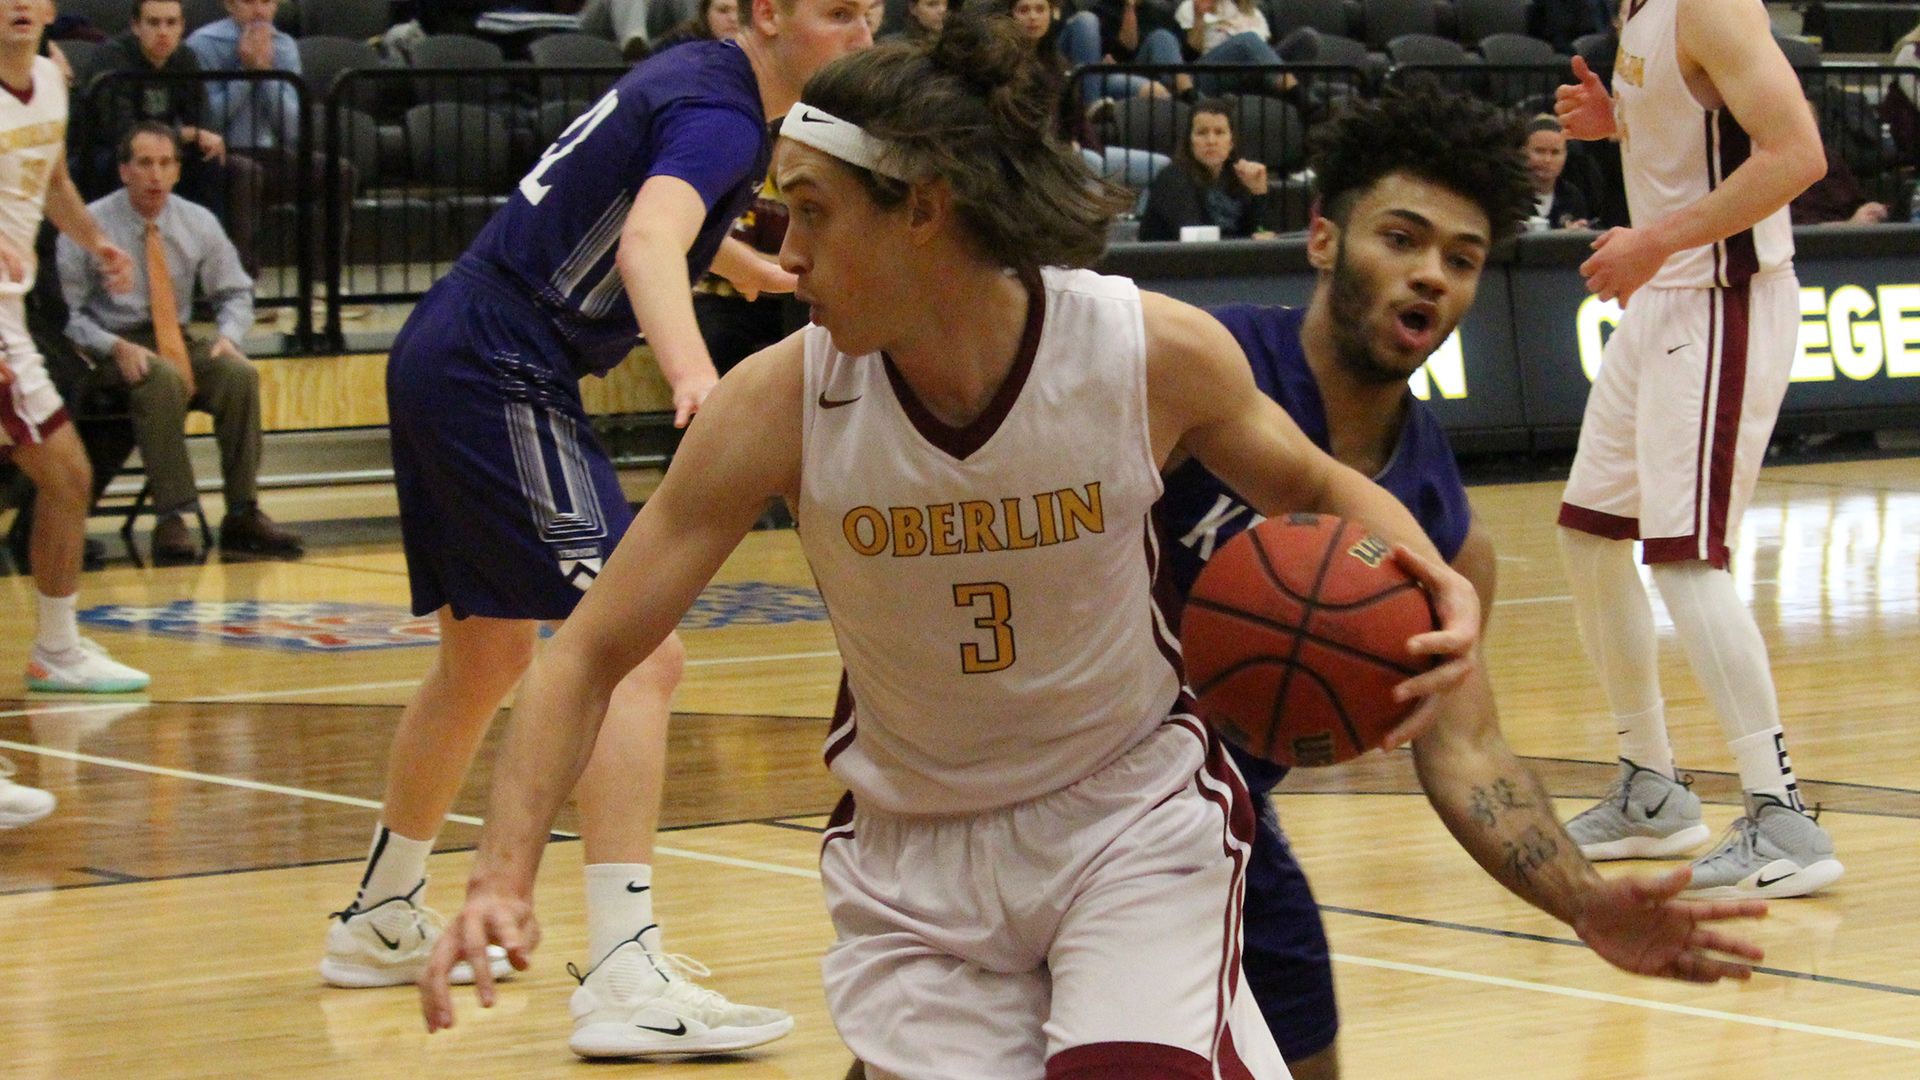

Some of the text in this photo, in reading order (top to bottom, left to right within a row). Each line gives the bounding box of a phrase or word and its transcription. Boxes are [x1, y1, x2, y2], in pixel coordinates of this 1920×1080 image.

[1576, 284, 1920, 382] CEGE
[842, 481, 1105, 557] OBERLIN
[953, 581, 1016, 674] 3
